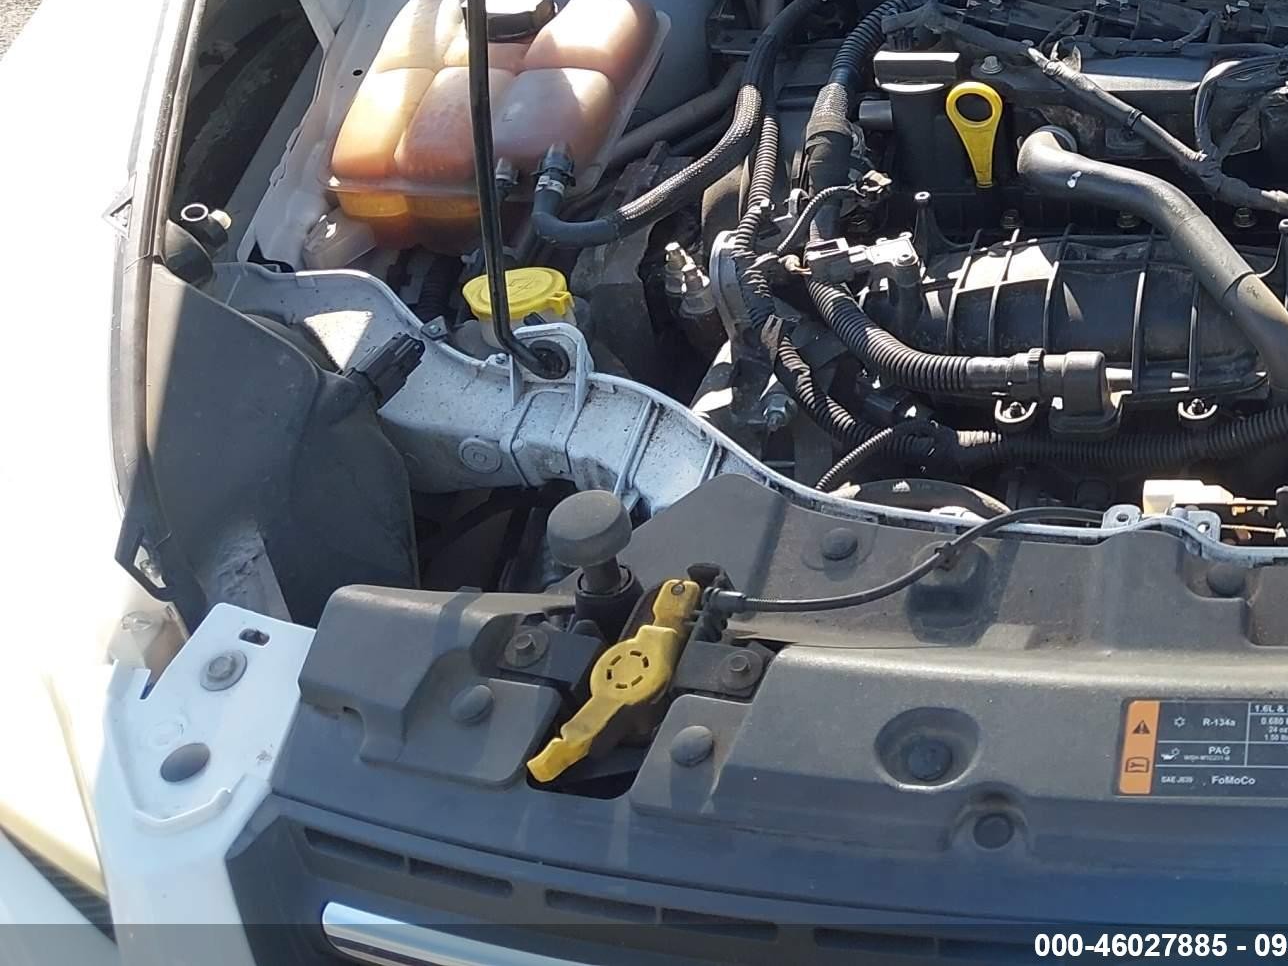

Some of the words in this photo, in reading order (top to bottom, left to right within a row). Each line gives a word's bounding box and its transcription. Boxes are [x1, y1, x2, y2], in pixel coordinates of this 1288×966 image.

[1202, 718, 1236, 727] R-134a
[1208, 746, 1231, 755] PAG
[1211, 776, 1256, 785] FoMoCo
